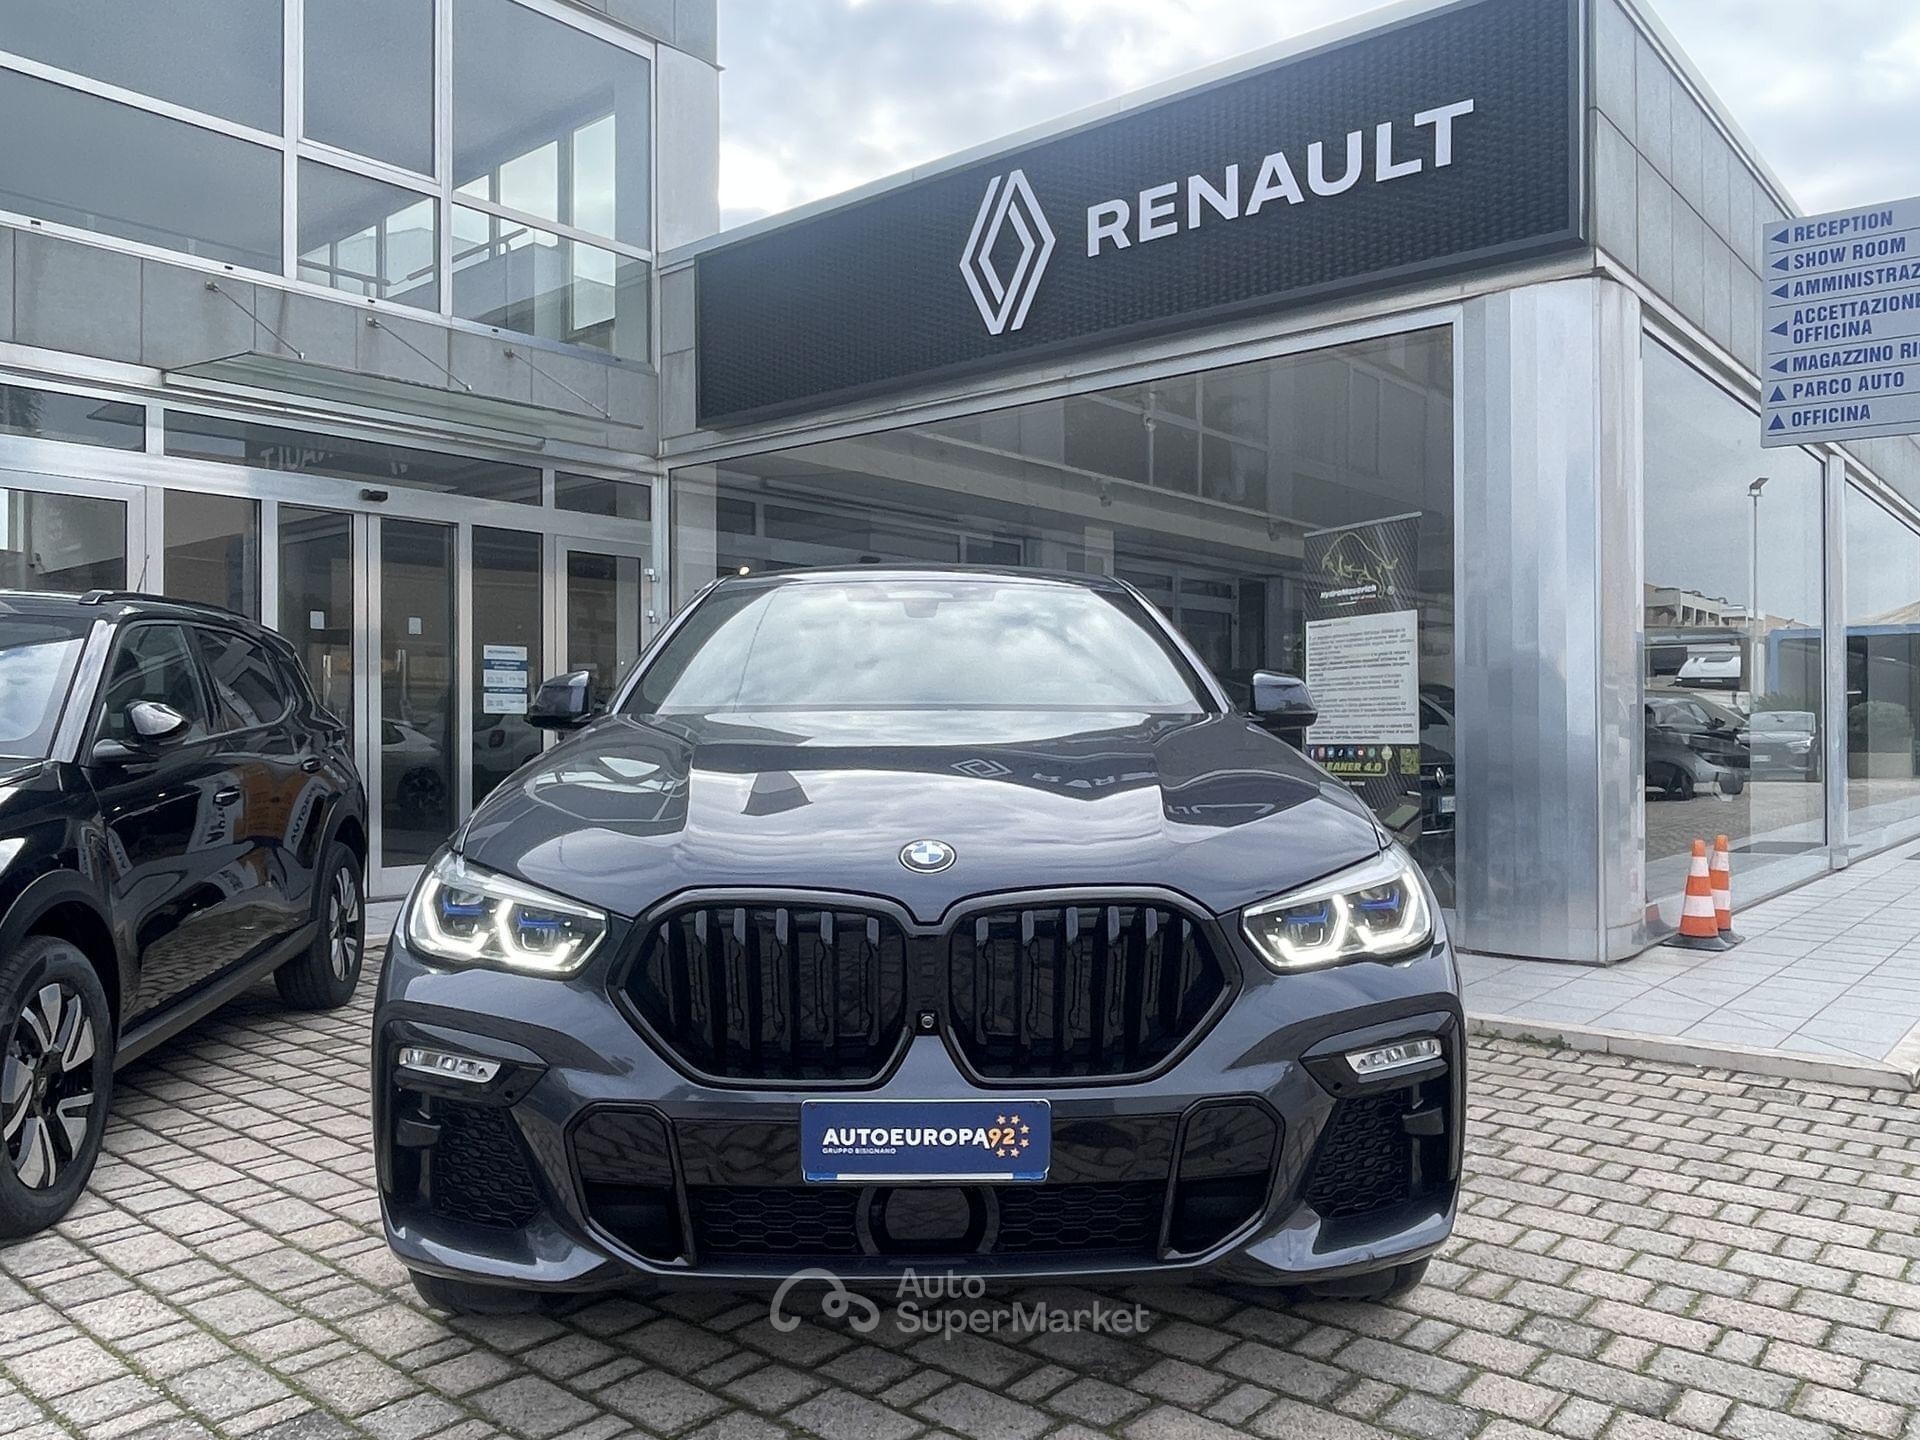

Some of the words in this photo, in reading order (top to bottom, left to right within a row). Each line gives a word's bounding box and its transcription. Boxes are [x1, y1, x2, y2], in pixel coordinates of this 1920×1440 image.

[1087, 99, 1475, 258] RENAULT
[1794, 211, 1893, 242] RECEPTION
[1794, 248, 1846, 270] SHOW
[1852, 237, 1906, 260] ROOM
[1794, 262, 1920, 297] AMMINISTRAZ
[1793, 292, 1920, 325] ACCETTAZIONE
[1793, 319, 1872, 344] OFFICINA
[1792, 345, 1893, 372] MAGAZZINO
[1900, 341, 1920, 359] RI
[1792, 379, 1851, 399] PARCO
[1858, 371, 1904, 391] AUTO
[1791, 404, 1871, 427] OFFICINA
[1364, 762, 1382, 772] 4.0
